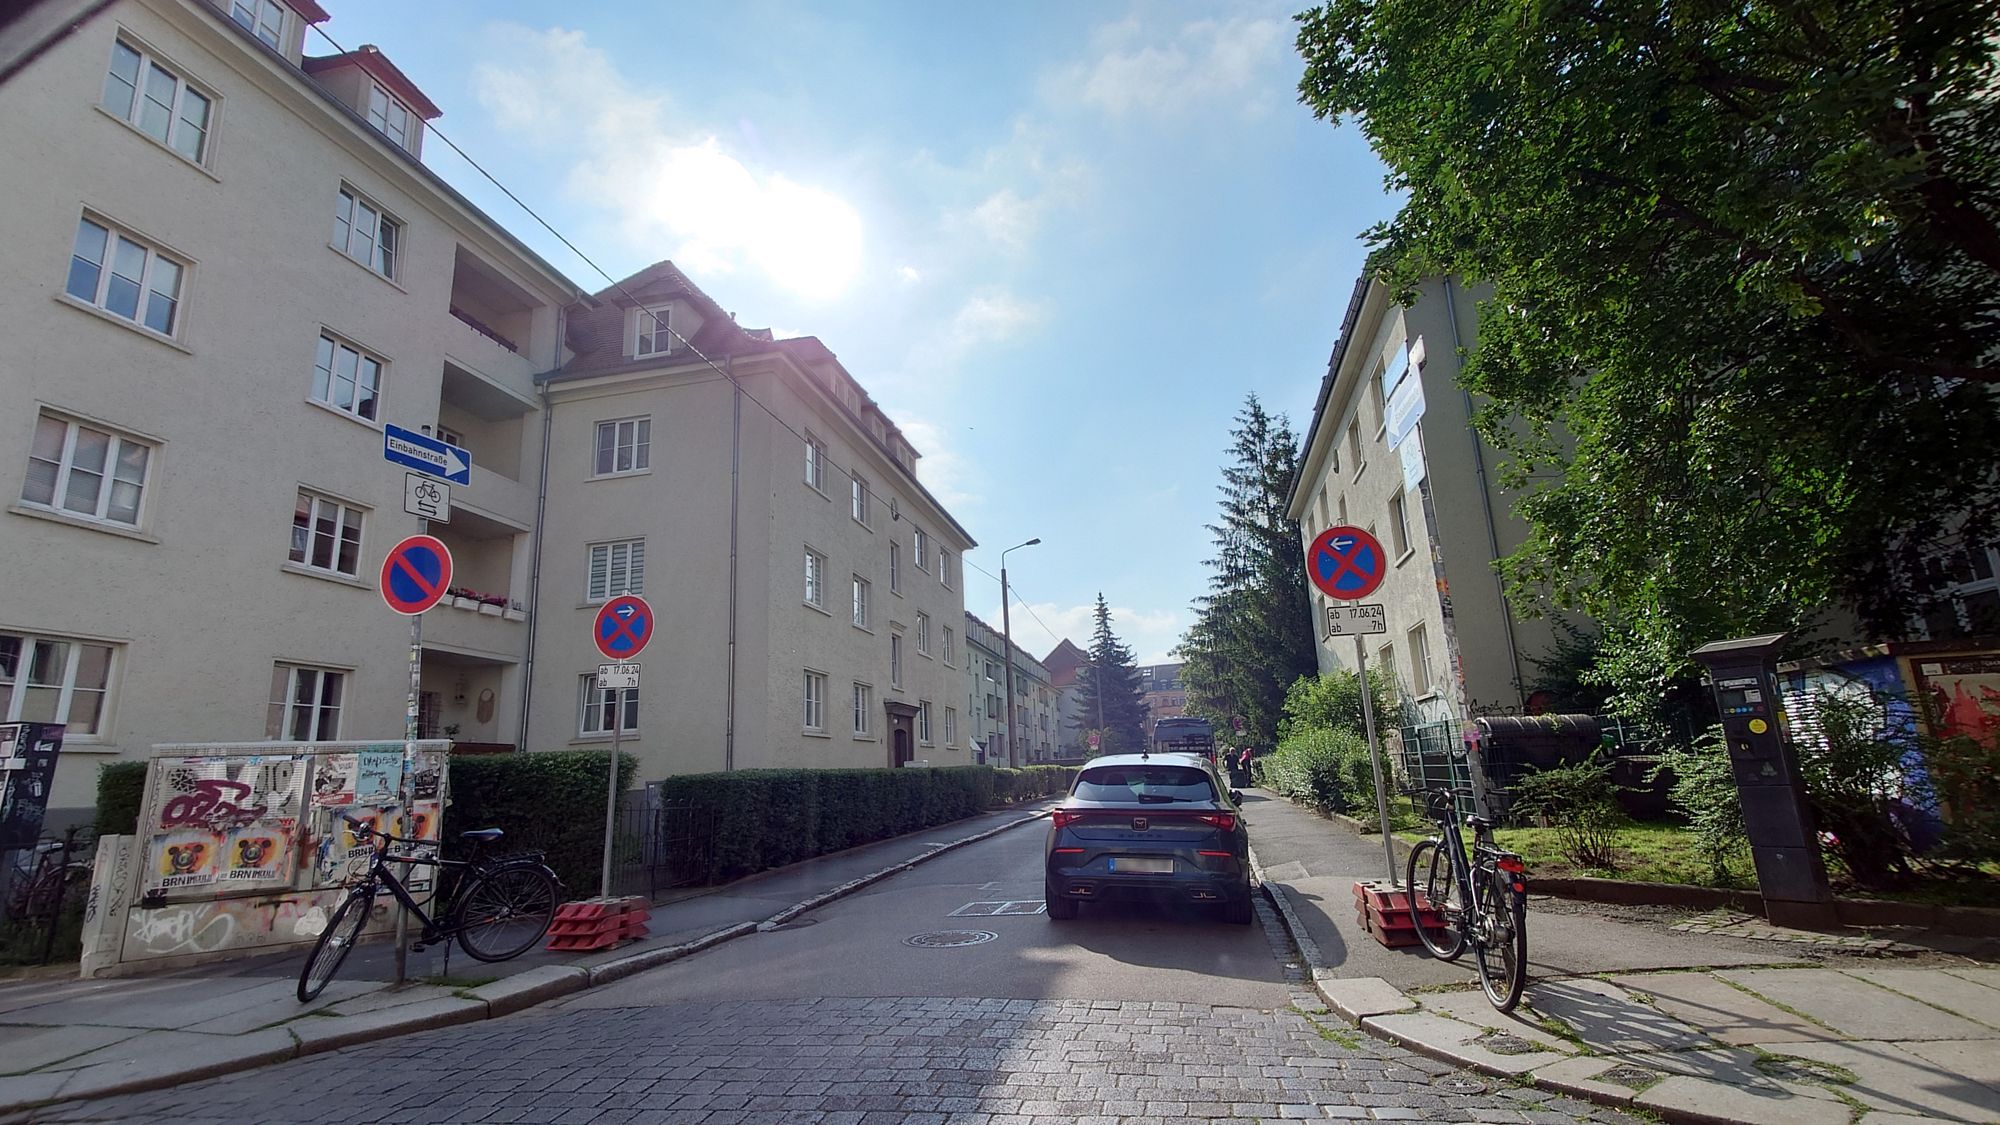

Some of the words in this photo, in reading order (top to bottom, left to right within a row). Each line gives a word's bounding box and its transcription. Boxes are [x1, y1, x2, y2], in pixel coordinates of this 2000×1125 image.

[390, 439, 448, 466] Einbahnstraße
[1329, 610, 1340, 620] ab
[1349, 607, 1382, 619] 17.06.24
[1331, 622, 1342, 633] ab
[600, 666, 608, 675] ab
[613, 665, 639, 675] 17.06.24
[599, 678, 607, 687] ab
